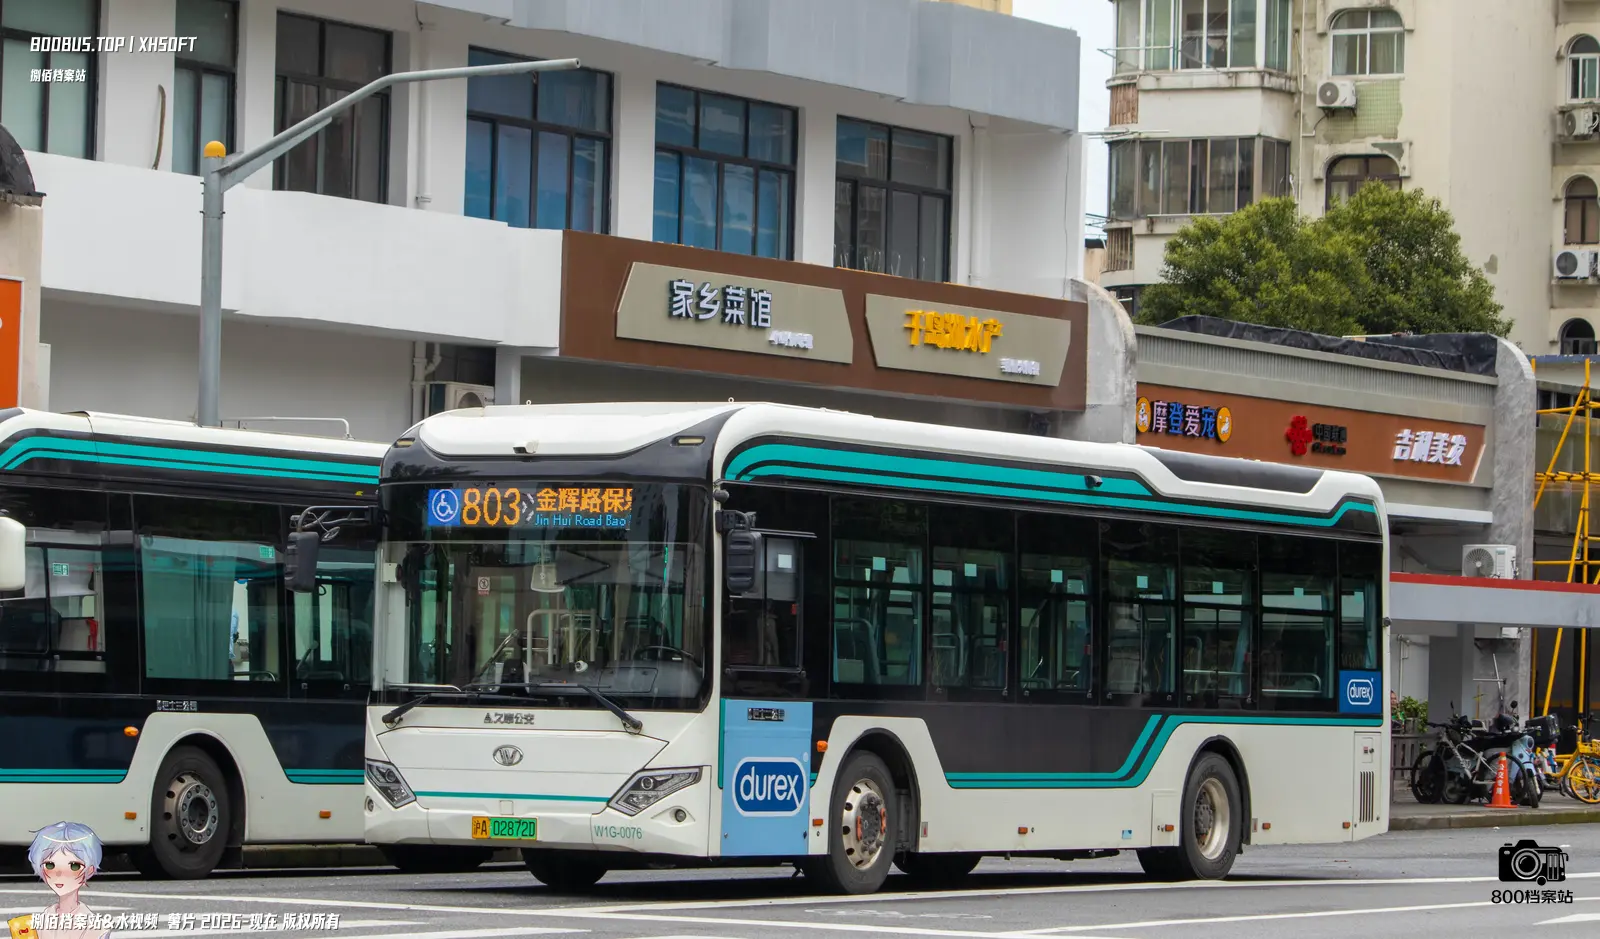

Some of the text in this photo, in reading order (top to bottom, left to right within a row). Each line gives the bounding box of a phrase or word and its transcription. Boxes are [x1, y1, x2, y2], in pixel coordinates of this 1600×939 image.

[669, 279, 772, 328] 家乡菜馆
[1151, 400, 1216, 438] 摩登爱宠
[462, 488, 521, 526] 803
[535, 515, 550, 526] Jin
[553, 514, 571, 526] Hui
[575, 514, 602, 526] Road
[1349, 683, 1371, 701] durex
[740, 766, 801, 808] durex
[594, 825, 643, 840] W1G-0076
